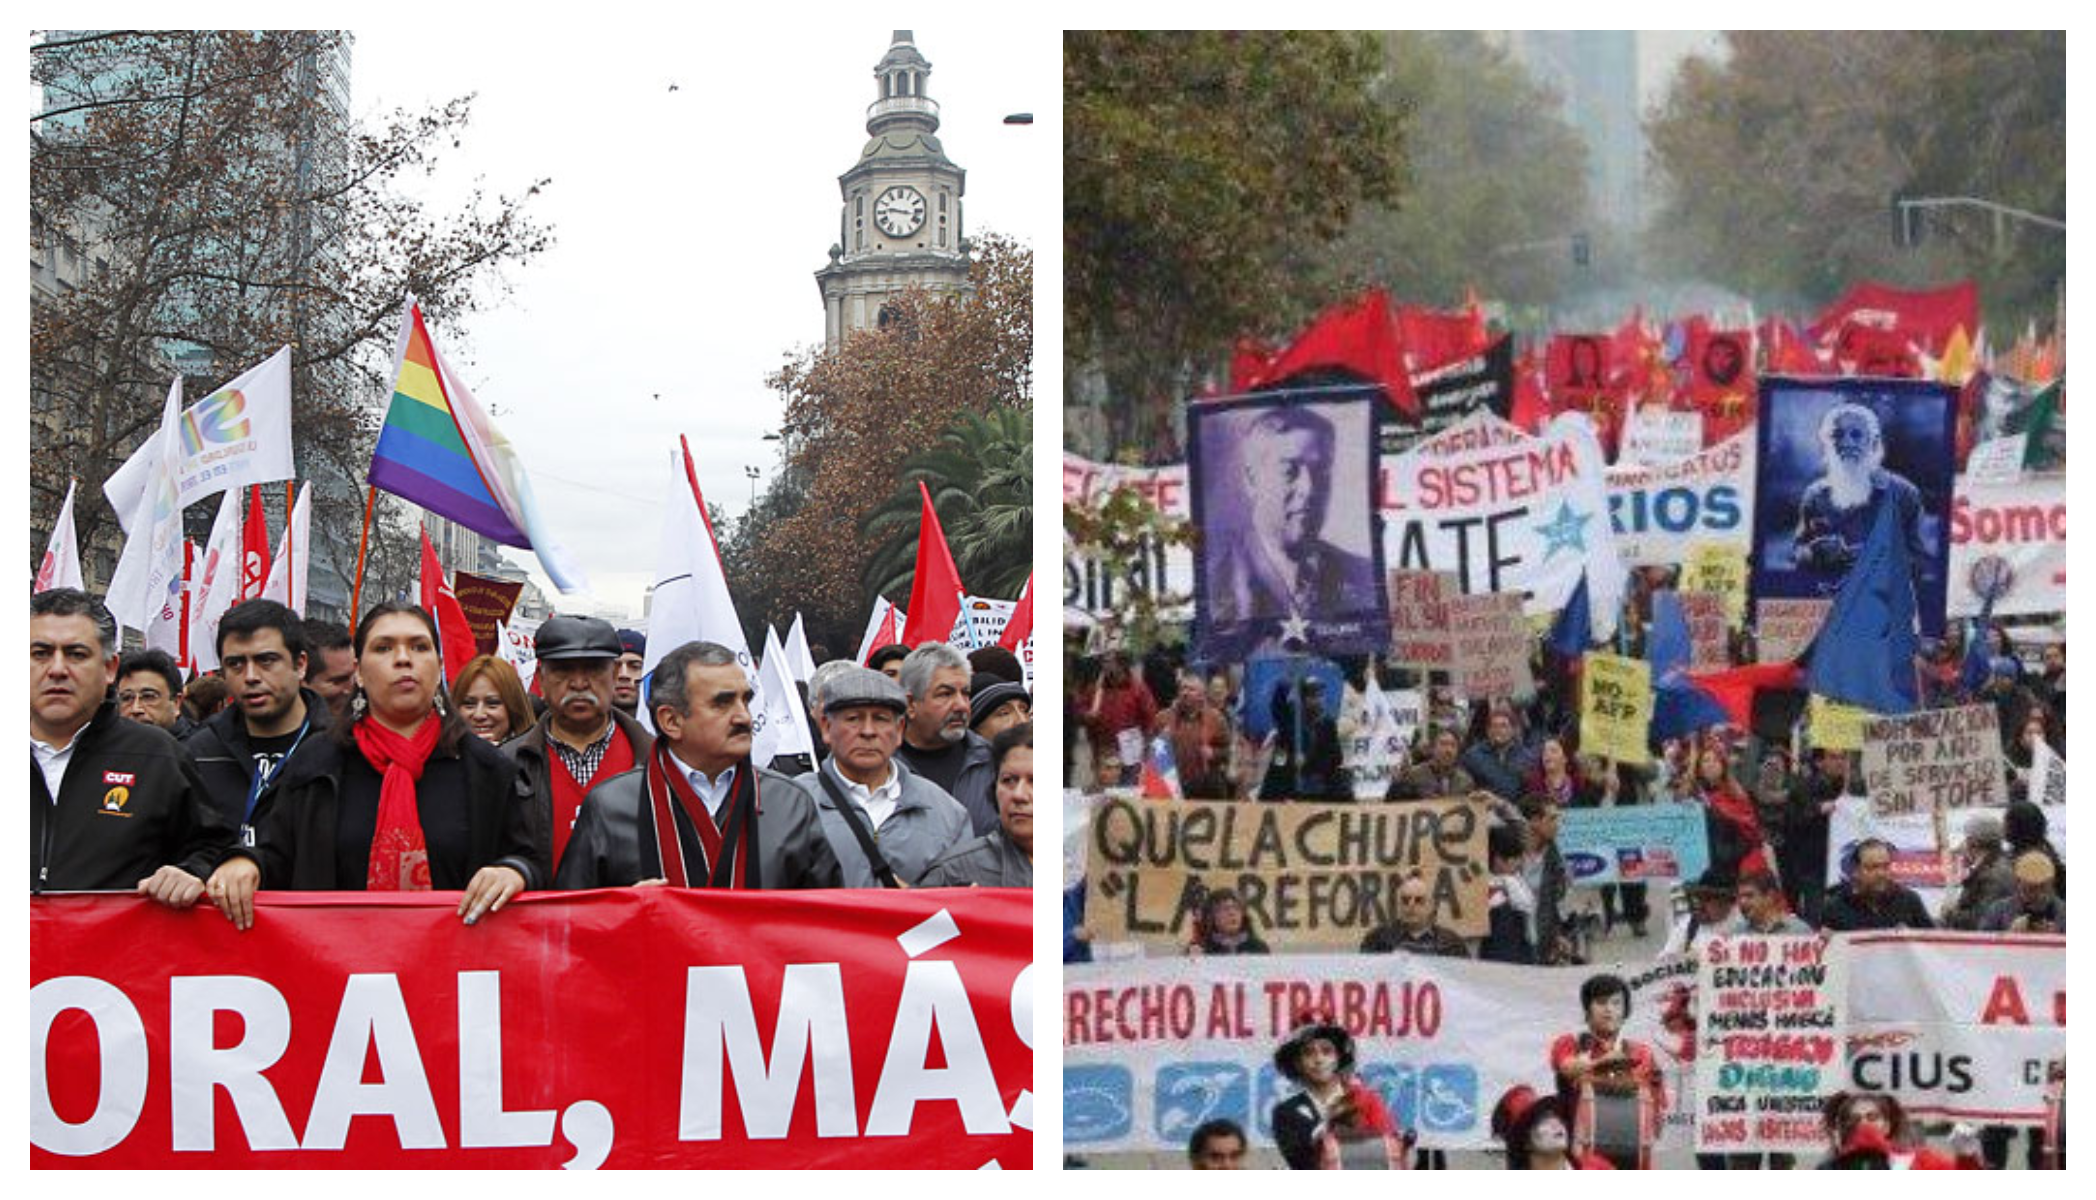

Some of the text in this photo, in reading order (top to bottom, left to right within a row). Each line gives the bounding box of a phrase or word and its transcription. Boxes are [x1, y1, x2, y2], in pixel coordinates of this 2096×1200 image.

[1418, 442, 1580, 509] SISTEMA
[104, 772, 134, 784] CUT
[1930, 779, 1993, 808] TOPE
[1206, 983, 1254, 1040] AL
[1263, 981, 1442, 1039] TRABAJO
[30, 908, 1033, 1170] ORAL, MÁ
[1851, 1051, 1974, 1093] CIUS
